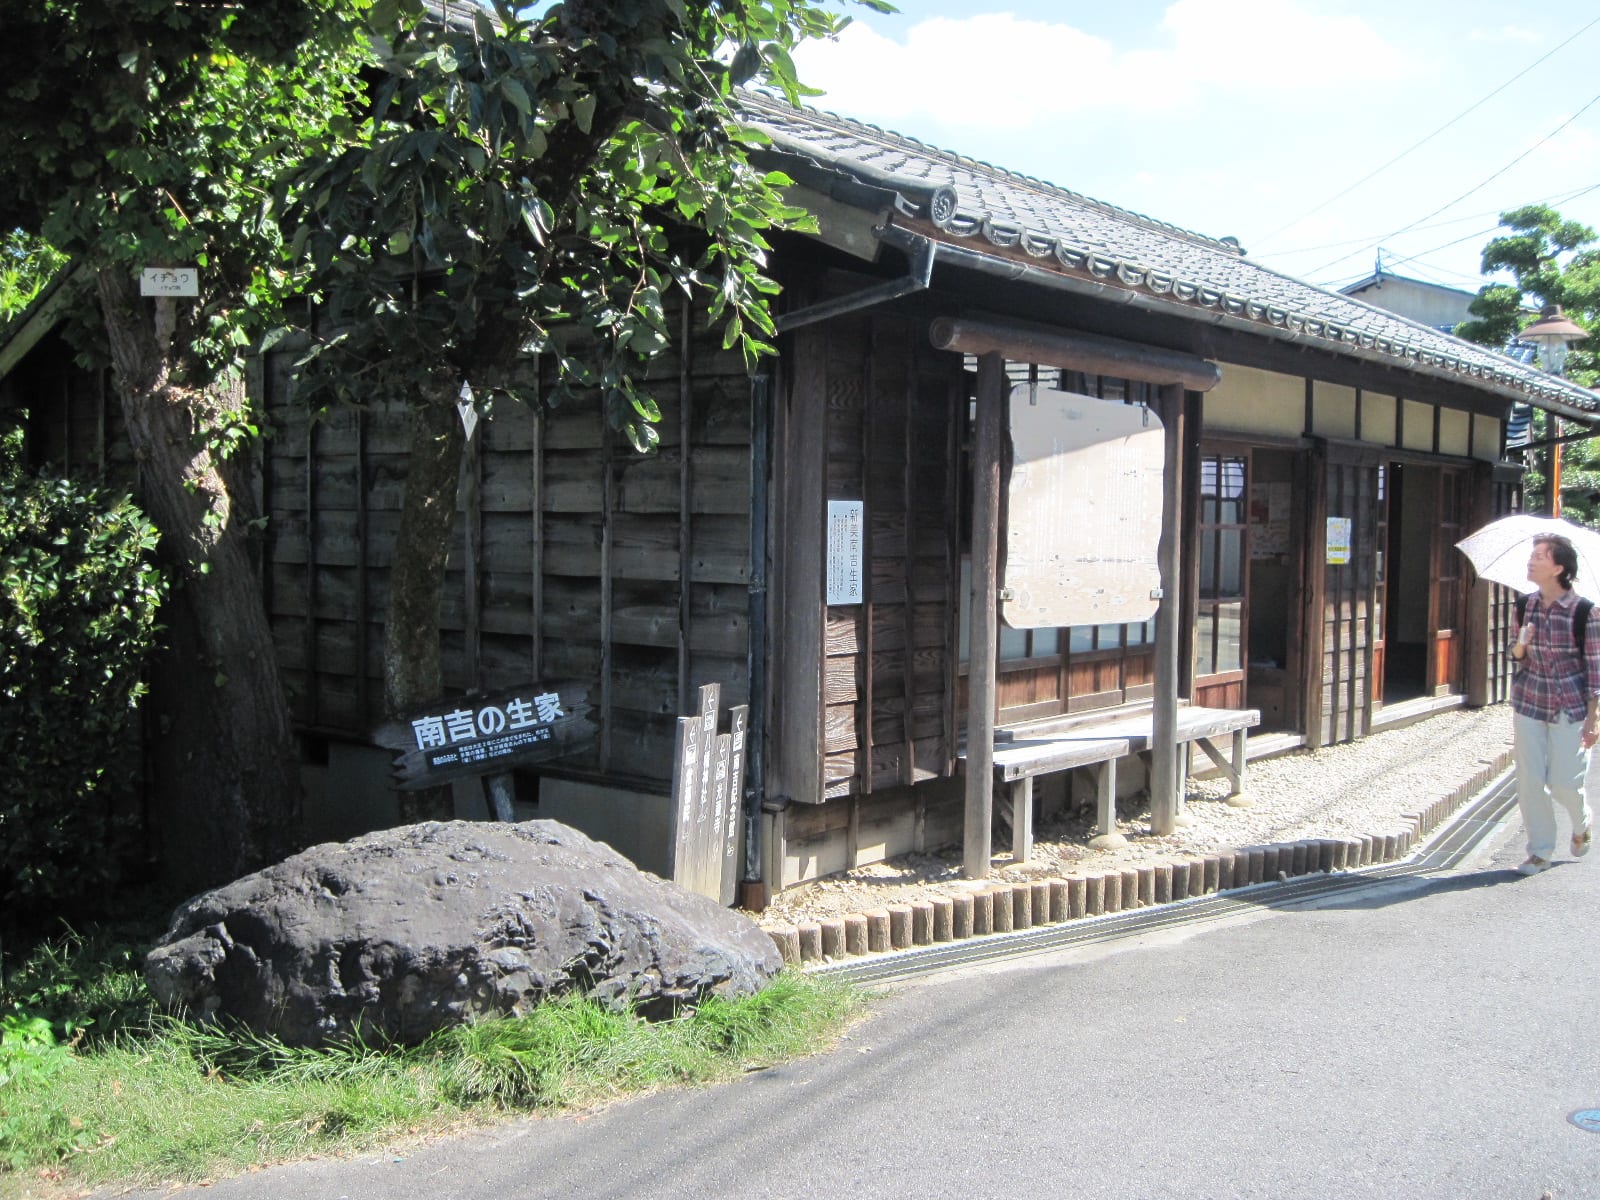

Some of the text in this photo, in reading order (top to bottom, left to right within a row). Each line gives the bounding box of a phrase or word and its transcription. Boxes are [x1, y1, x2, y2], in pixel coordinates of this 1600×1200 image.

[411, 692, 564, 750] 南吉の生家
